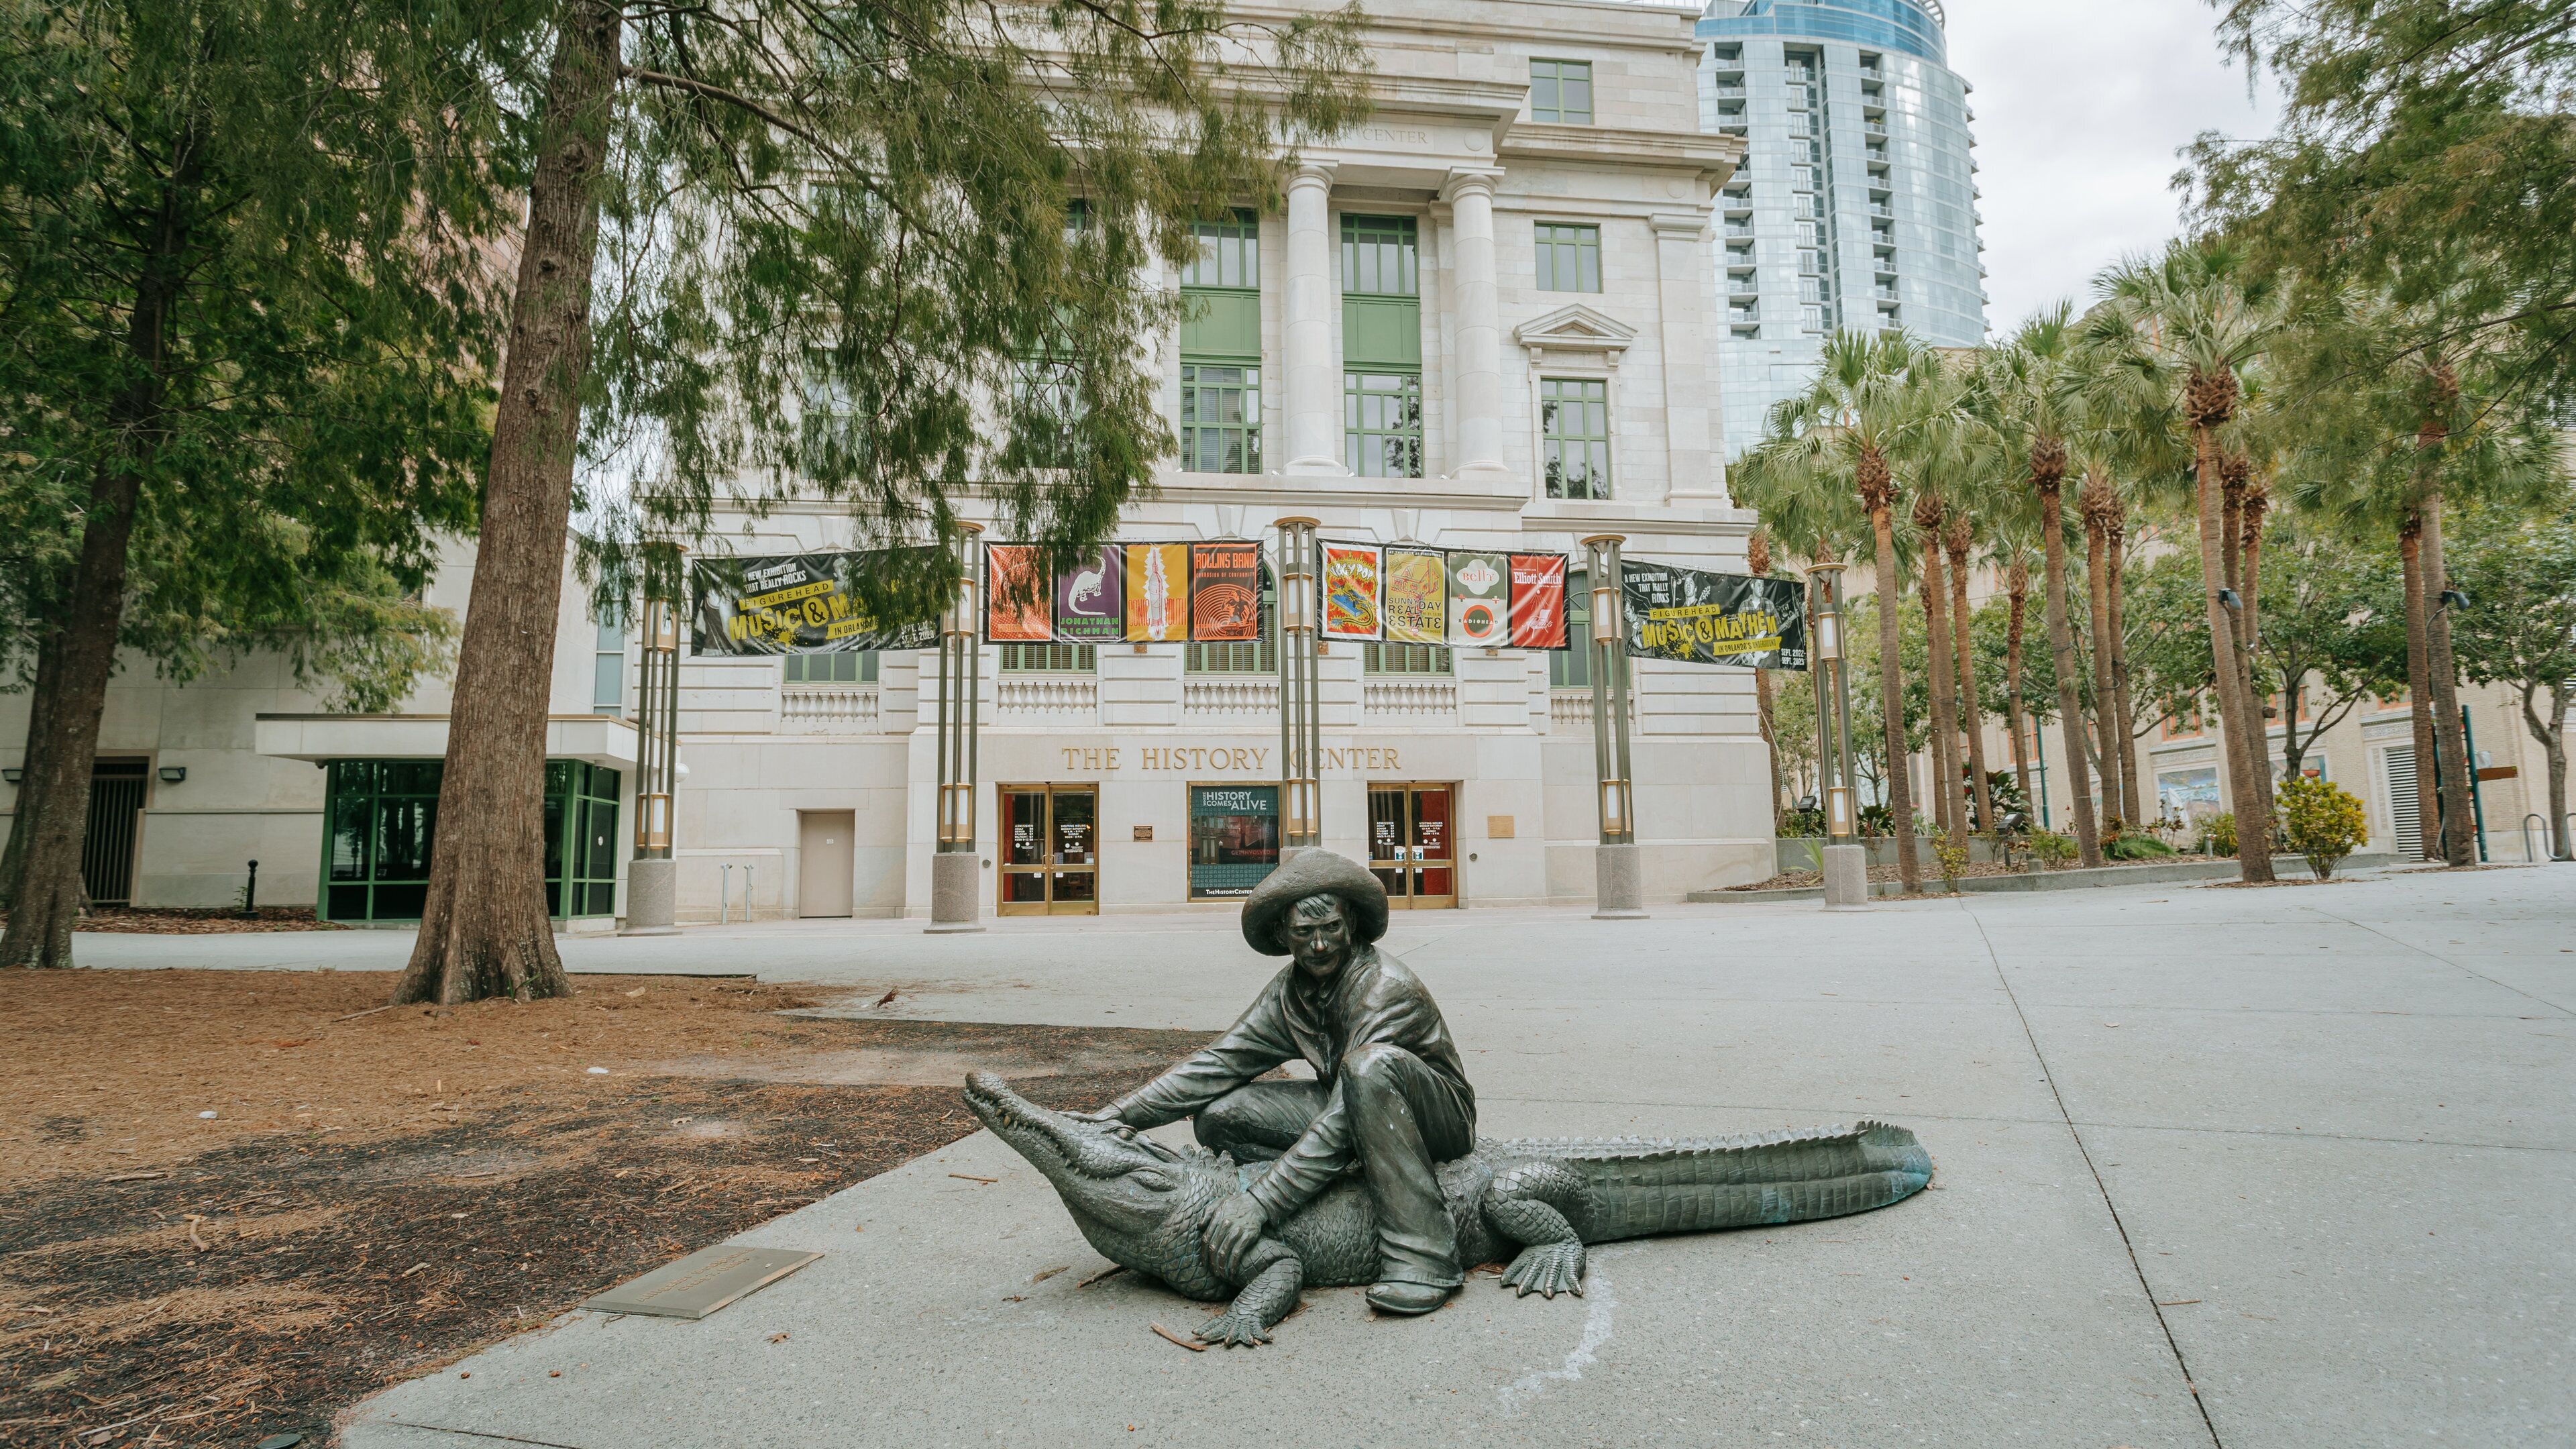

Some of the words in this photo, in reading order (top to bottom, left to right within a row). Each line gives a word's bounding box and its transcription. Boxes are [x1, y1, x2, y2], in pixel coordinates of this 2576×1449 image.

[1362, 128, 1428, 144] CENTER
[1196, 553, 1230, 569] ROLLINS
[1233, 553, 1254, 568] BAND
[747, 570, 762, 582] NEW
[763, 563, 797, 578] EXHIBITION
[1330, 563, 1356, 577] IGGY
[1356, 564, 1374, 580] POP
[744, 582, 759, 594] THAT
[760, 577, 784, 590] REALLY
[784, 570, 806, 586] ROCKS
[1513, 572, 1537, 584] Elliott
[1538, 572, 1562, 584] Smith
[1625, 574, 1629, 583] A
[1629, 574, 1640, 582] NEW
[1641, 572, 1668, 582] EXHIBITION
[1638, 584, 1650, 592] THAT
[1652, 582, 1668, 592] REALLY
[745, 583, 828, 607] FIGUREHEAD
[1652, 593, 1670, 604] ROCKS
[1389, 605, 1419, 614] REAL
[1419, 601, 1441, 610] DAY
[1128, 599, 1150, 626] SONIC
[1164, 598, 1187, 626] YOUTH
[1653, 606, 1717, 617] FIGUREHEAD
[729, 607, 802, 641] MUSIC
[808, 601, 826, 623] &
[1061, 617, 1118, 625] JONATHAN
[1389, 615, 1441, 629] ESTATE
[835, 627, 842, 636] IN
[1642, 619, 1696, 648] MUSIC
[1700, 621, 1711, 640] &
[1714, 611, 1777, 640] MAYHEM
[1725, 642, 1752, 652] ORLANDO'S
[1781, 649, 1792, 657] SEPT.
[1782, 657, 1792, 665] SEPT.
[1061, 747, 1121, 769] THE
[1141, 747, 1269, 769] HISTORY
[1290, 747, 1401, 769] CENTER
[1206, 792, 1252, 800] HISTORY
[1231, 800, 1267, 810] ALIVE
